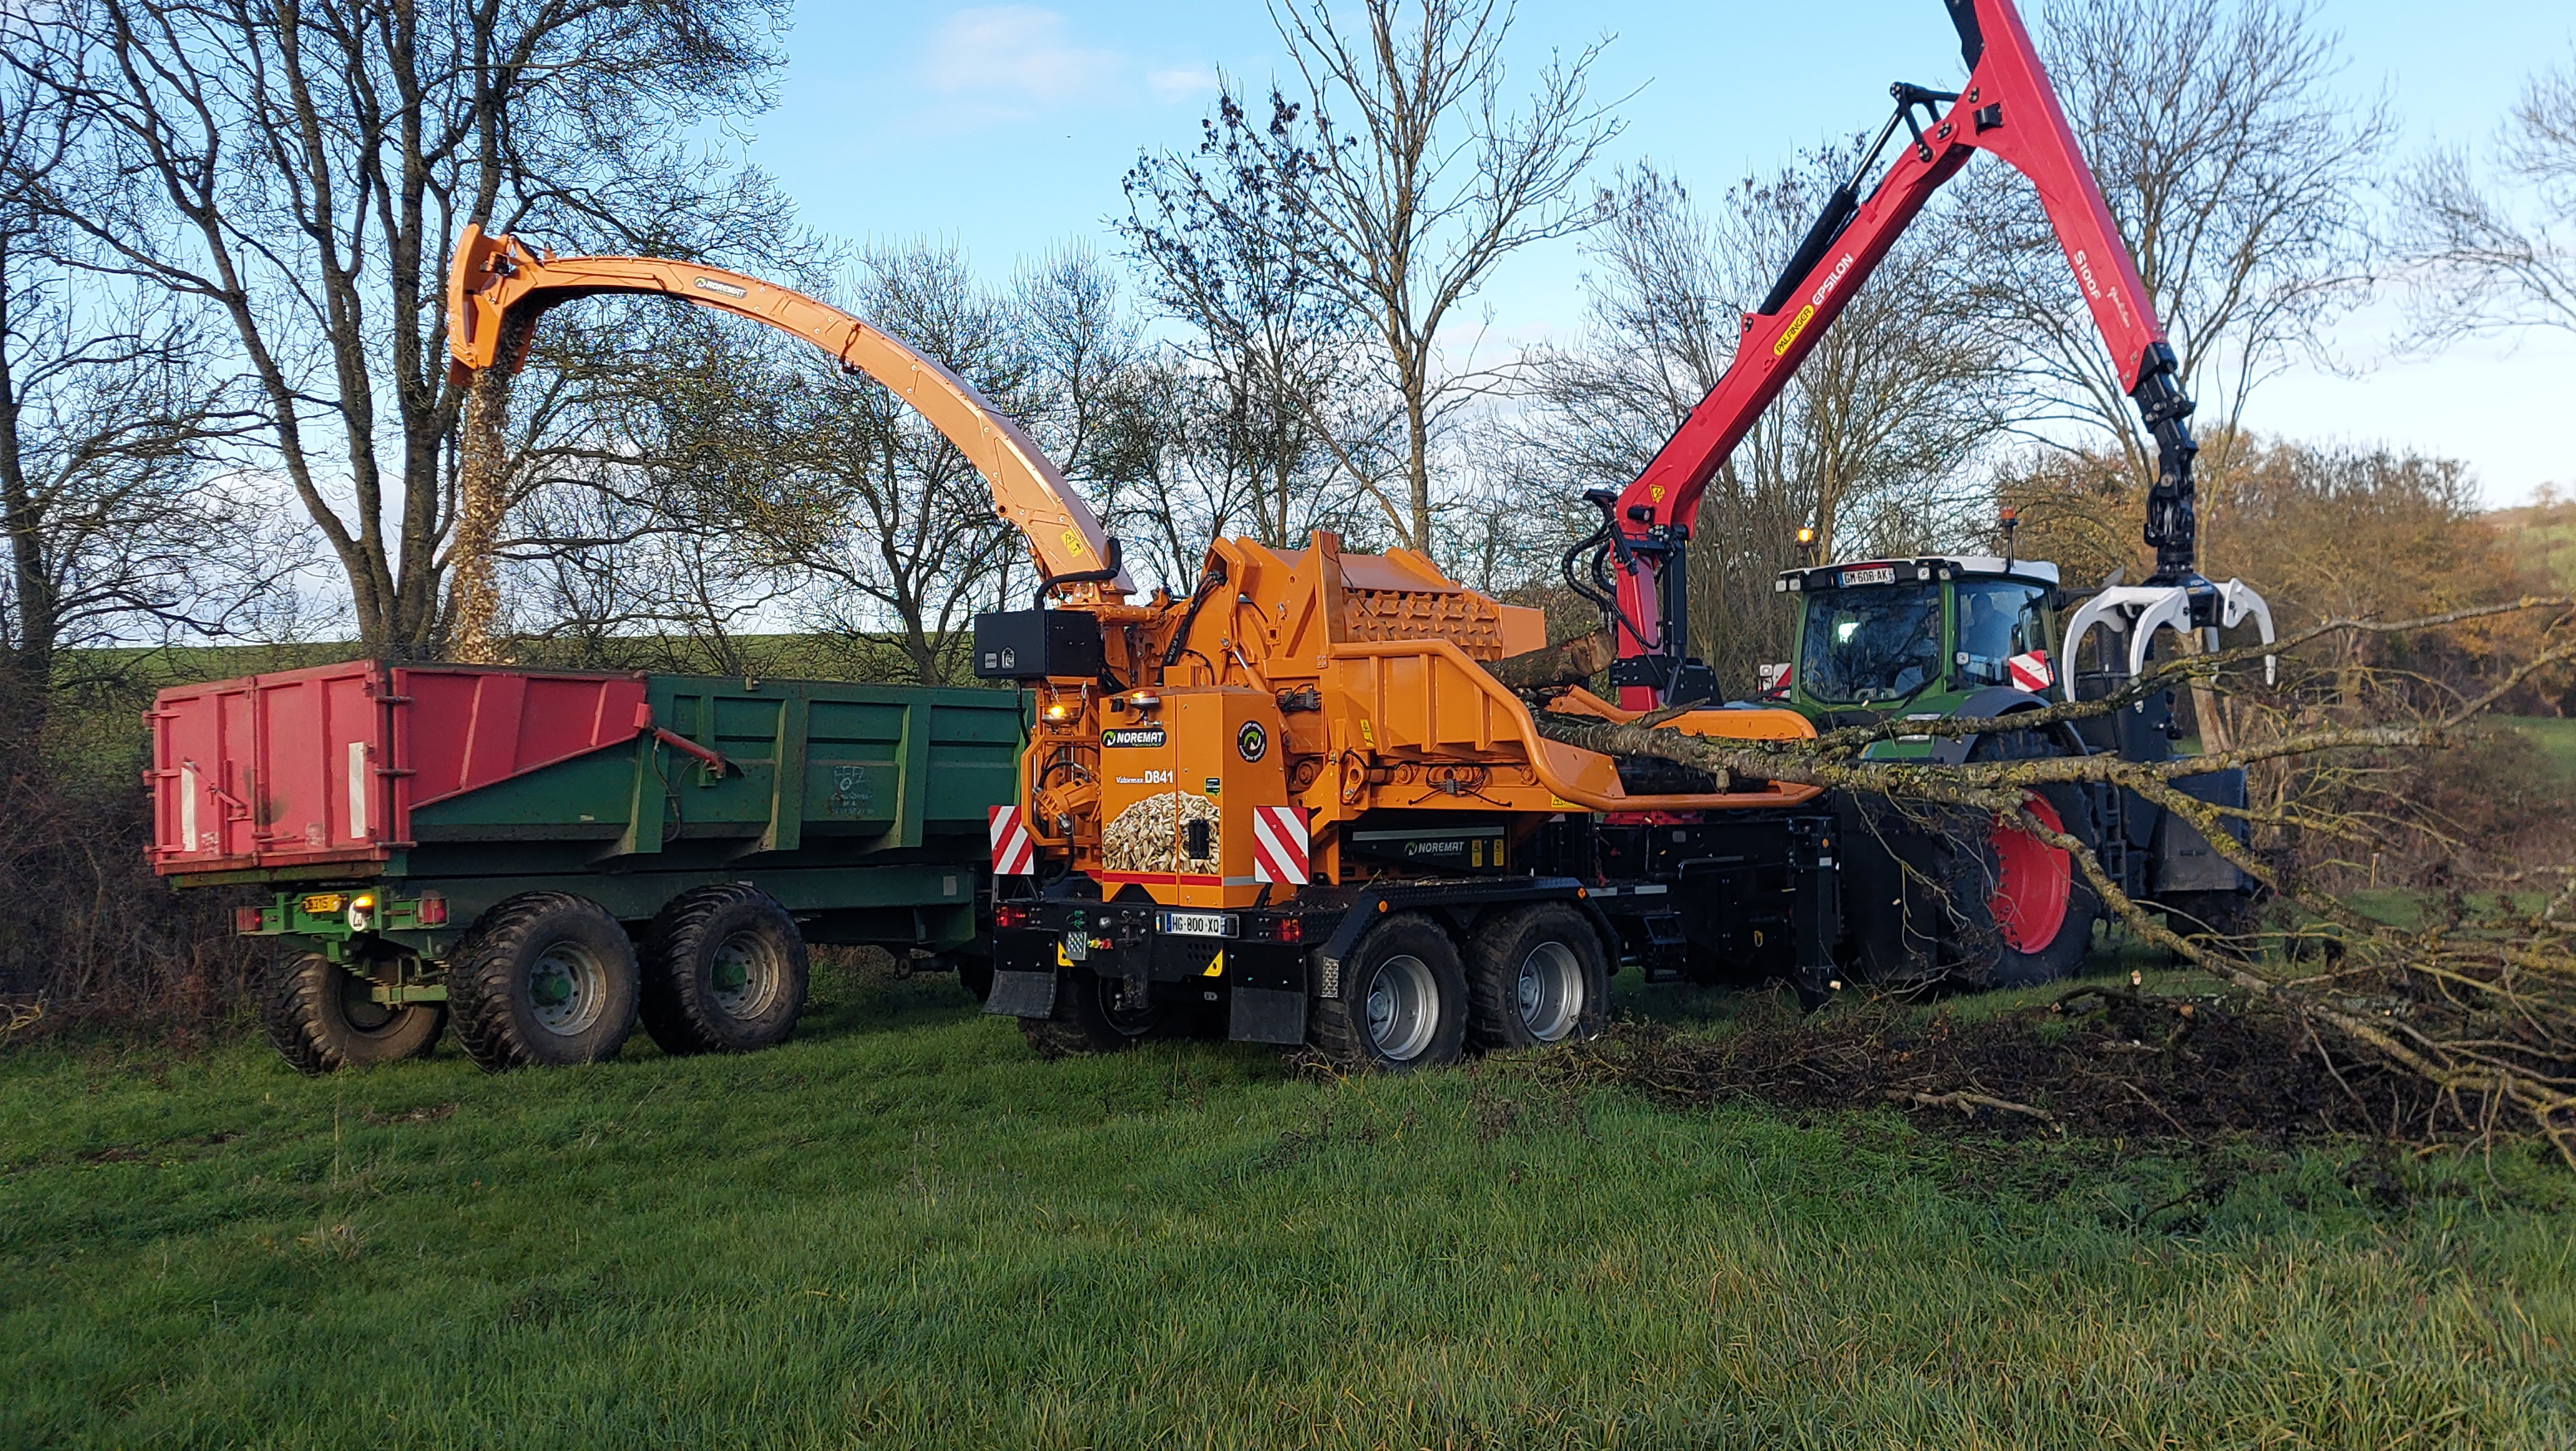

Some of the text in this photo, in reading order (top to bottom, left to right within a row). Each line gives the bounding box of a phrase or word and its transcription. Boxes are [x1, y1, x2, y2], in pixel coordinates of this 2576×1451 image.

[1812, 252, 1853, 305] EPSILON
[2074, 250, 2101, 300] S100F
[1775, 308, 1812, 353] PALFINGER
[1116, 732, 1164, 743] NOREMAT
[1145, 768, 1173, 783] D841
[1418, 841, 1465, 853] NOREMAT
